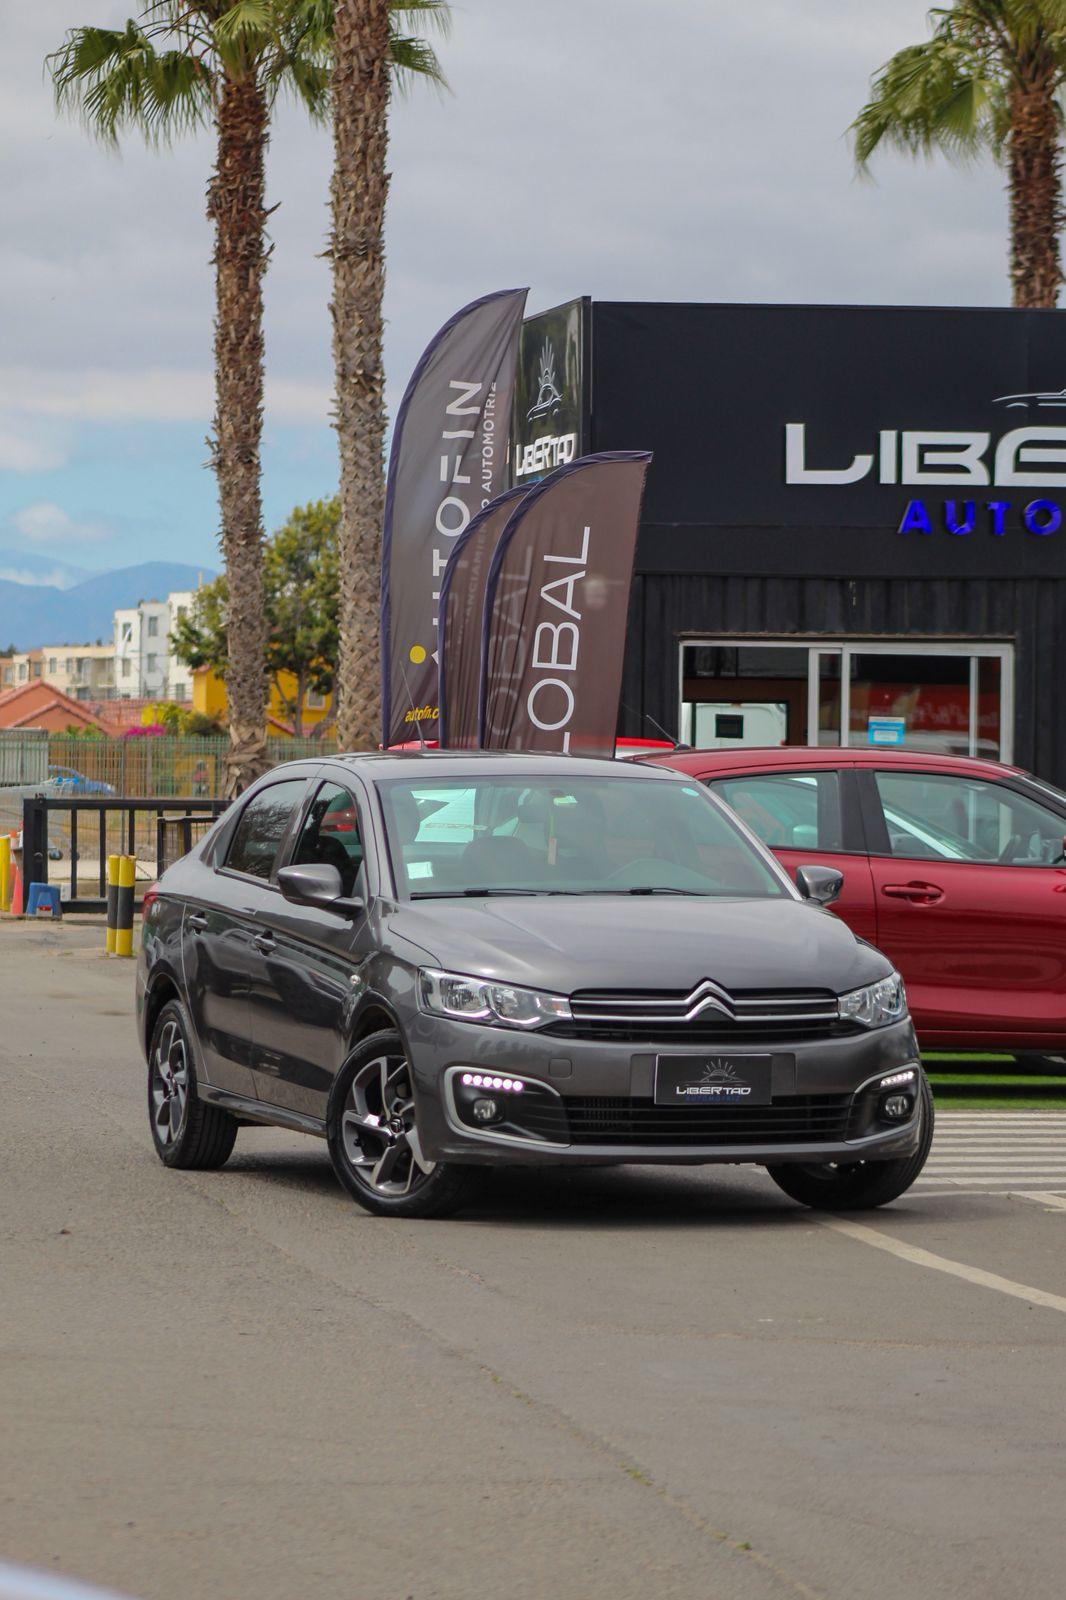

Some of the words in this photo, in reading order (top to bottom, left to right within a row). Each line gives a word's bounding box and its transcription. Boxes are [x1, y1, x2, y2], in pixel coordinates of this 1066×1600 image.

[431, 380, 482, 668] UTOFIN
[897, 500, 1063, 536] AUTO
[486, 546, 533, 750] OBAL
[527, 526, 591, 753] OBAL
[676, 1086, 751, 1095] LIBERTAD
